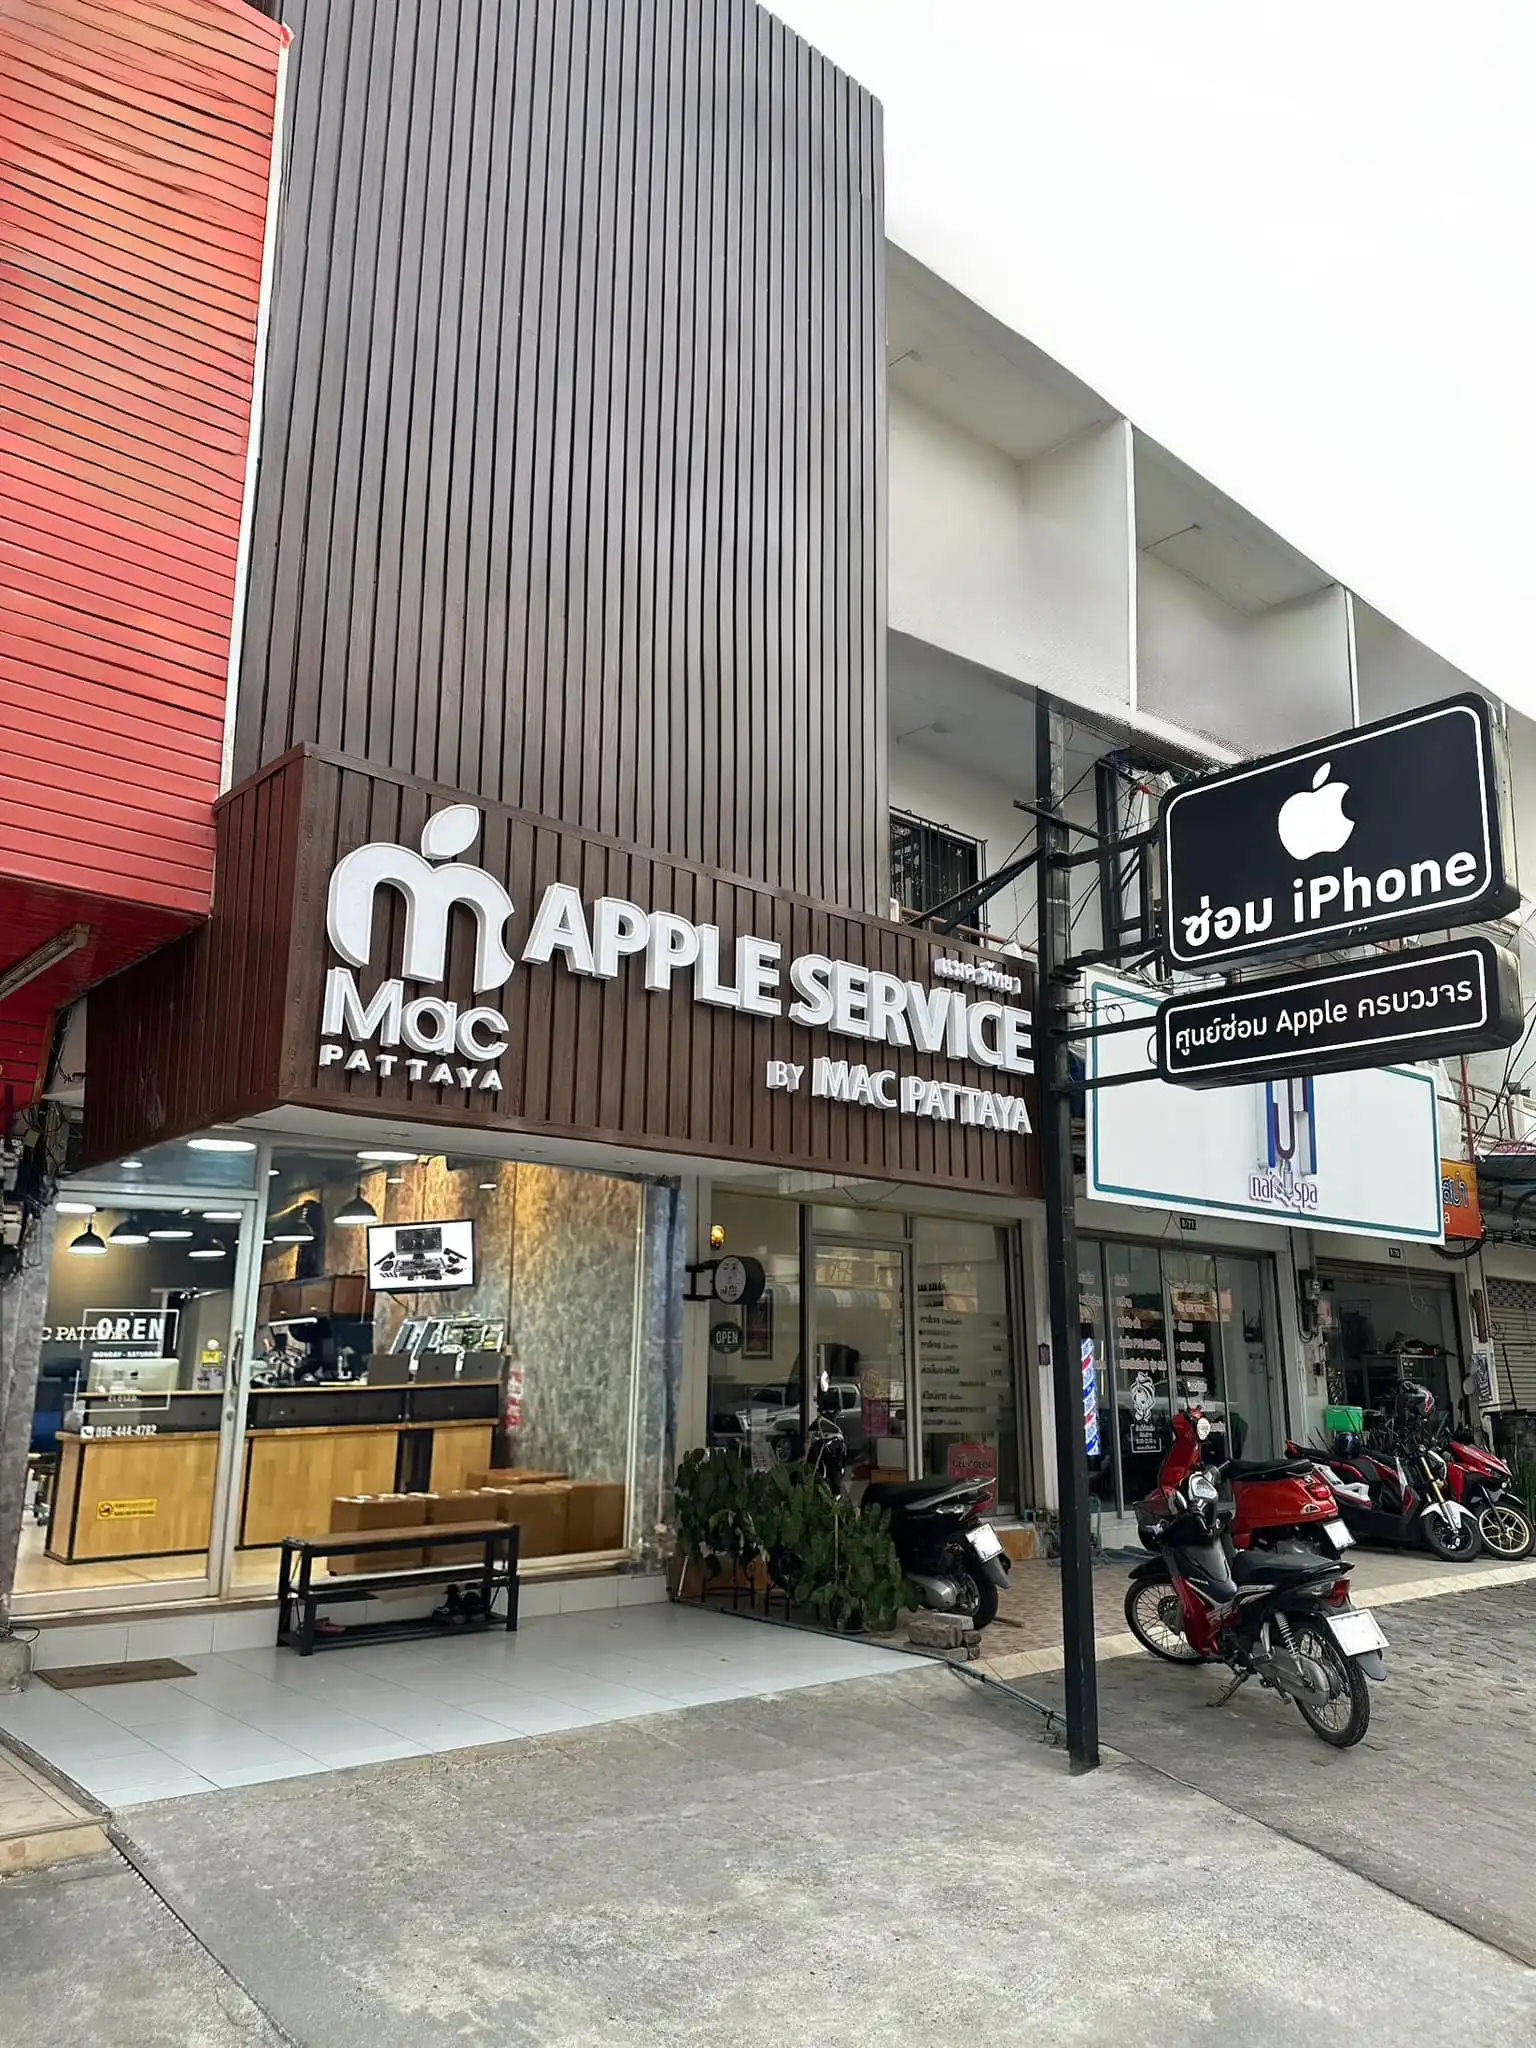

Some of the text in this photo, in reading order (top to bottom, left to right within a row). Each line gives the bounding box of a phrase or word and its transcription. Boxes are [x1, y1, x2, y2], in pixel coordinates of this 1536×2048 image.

[1181, 850, 1477, 947] ซ่อม iPhone
[321, 966, 509, 1062] Mac
[521, 882, 1036, 1075] APPLE SERVICE
[1175, 978, 1474, 1057] ศูนย์ซ่อม Apple ครบวงจร
[319, 1044, 504, 1091] PATTAYA
[766, 1056, 1033, 1135] BY MAC PATTAYA
[1294, 1182, 1318, 1209] spa
[97, 1317, 165, 1340] OPEN
[715, 1330, 739, 1345] OPEN
